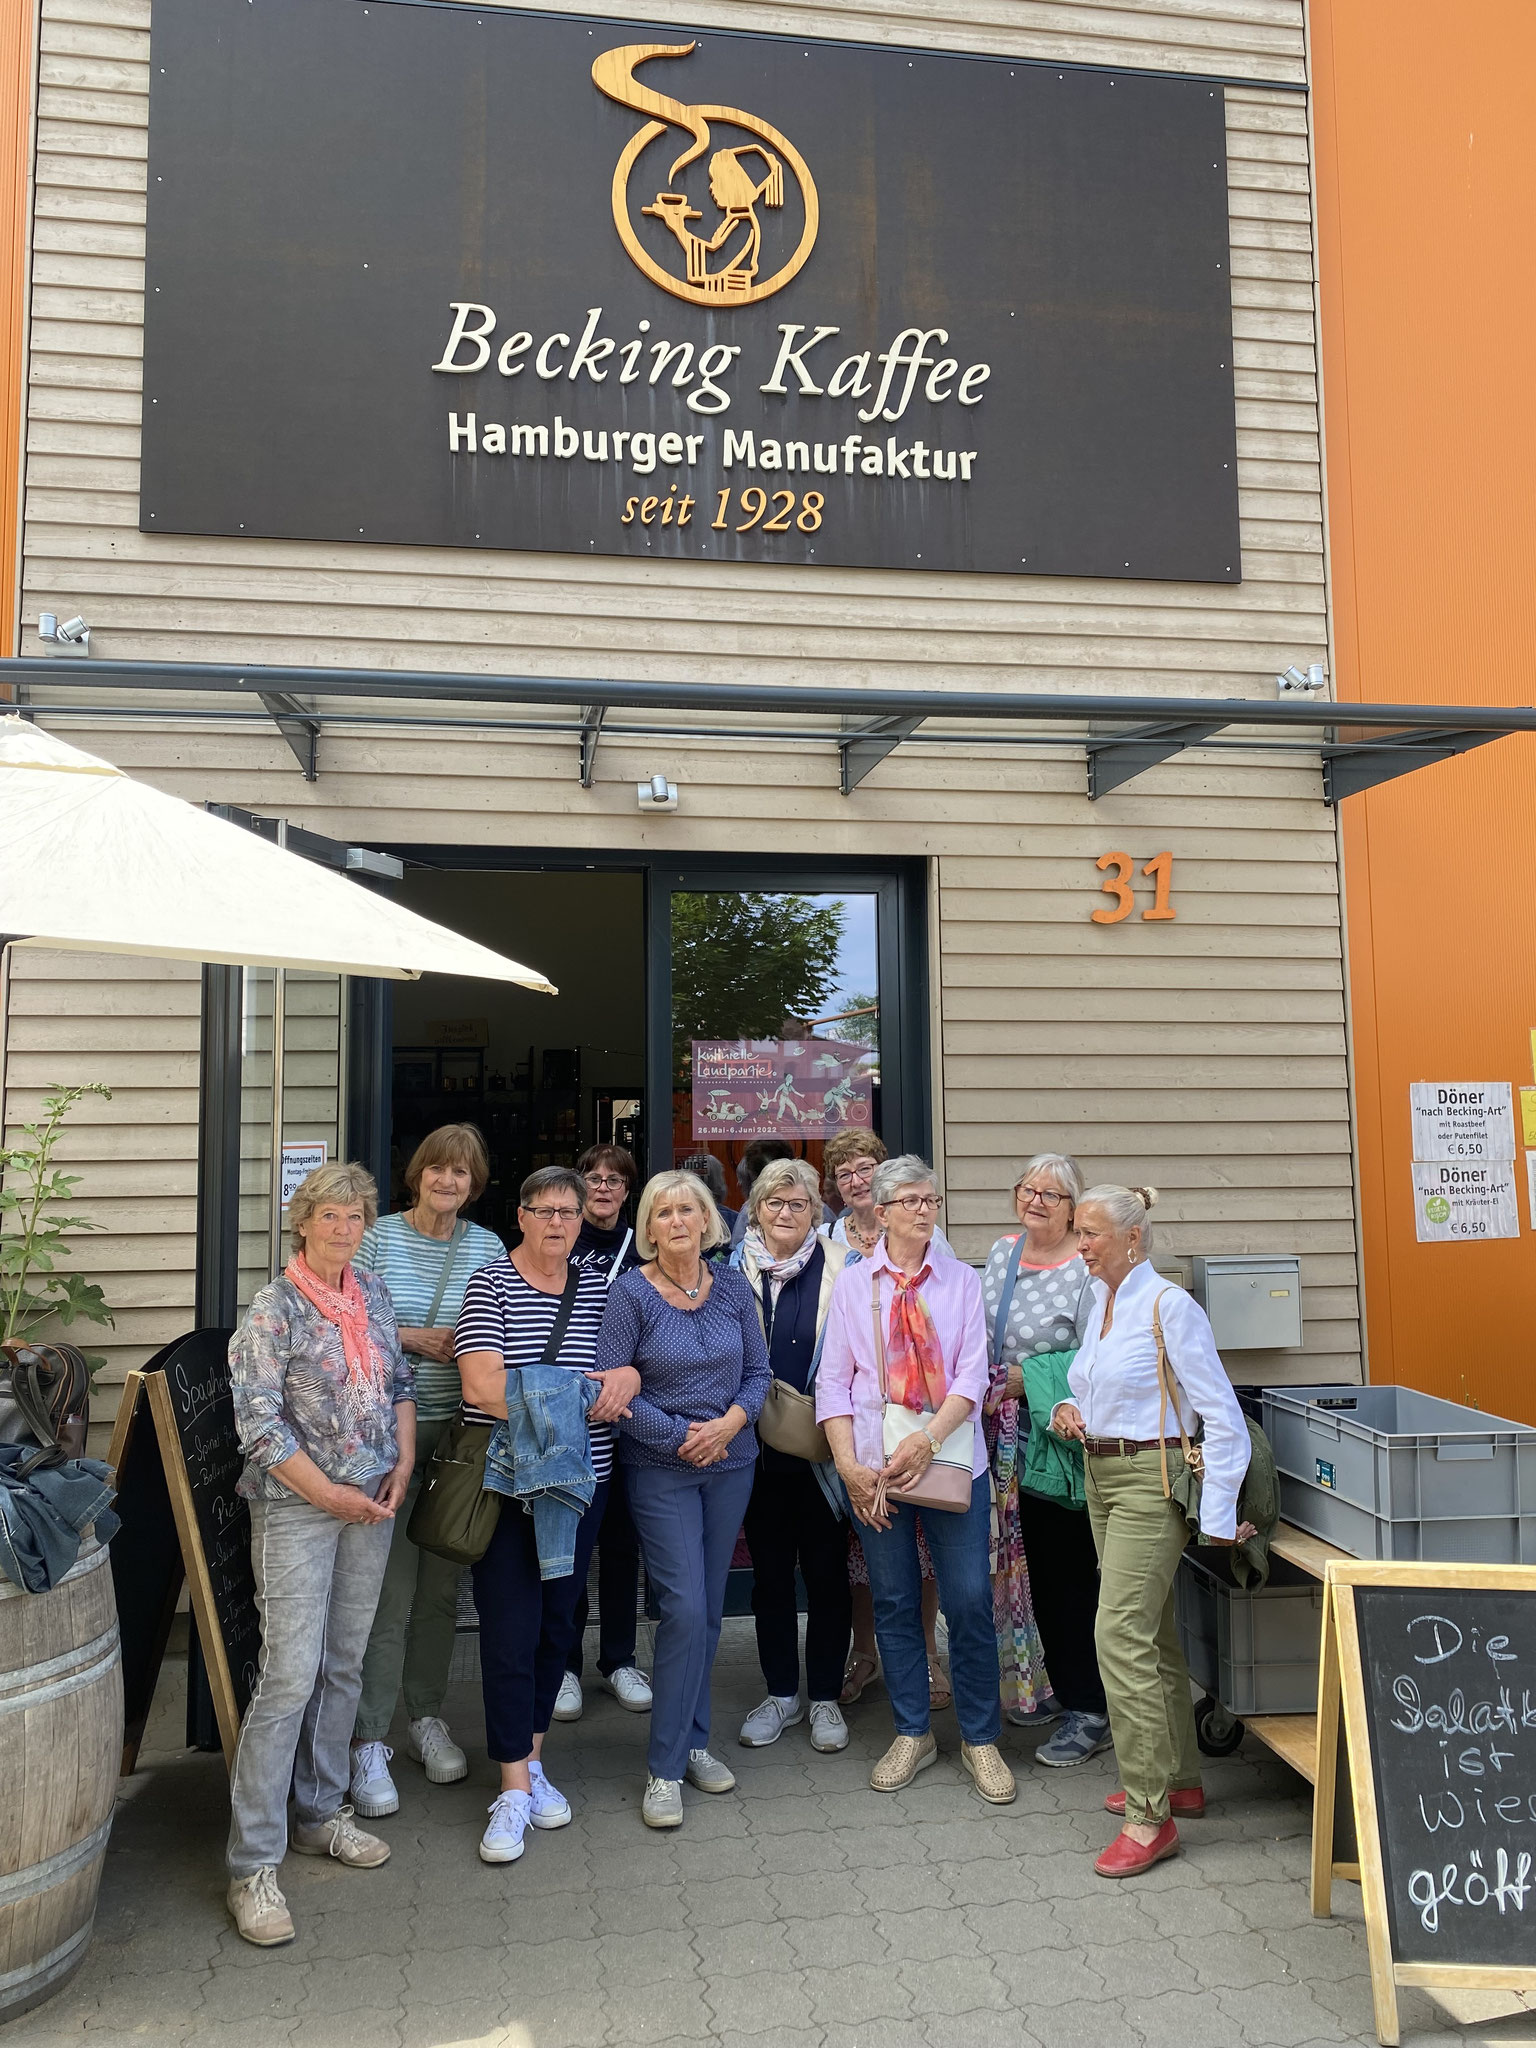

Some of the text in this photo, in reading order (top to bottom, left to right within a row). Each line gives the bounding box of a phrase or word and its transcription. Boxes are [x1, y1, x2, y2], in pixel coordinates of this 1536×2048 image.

[431, 302, 992, 422] Becking Kaffee
[448, 412, 978, 481] Hamburger Manufaktur
[620, 484, 826, 533] seit 1928
[1091, 851, 1177, 924] 31
[1437, 1088, 1485, 1105] Döner
[757, 1126, 778, 1134] 2022
[1452, 1120, 1486, 1128] Roastbeef
[1454, 1132, 1489, 1140] Putenfilet
[1457, 1143, 1483, 1156] 6,50
[675, 1161, 708, 1170] GUIDE
[1439, 1167, 1487, 1183] Döner
[1460, 1222, 1486, 1235] 6,50
[1406, 1614, 1519, 1666] Die
[1439, 1740, 1515, 1779] ist
